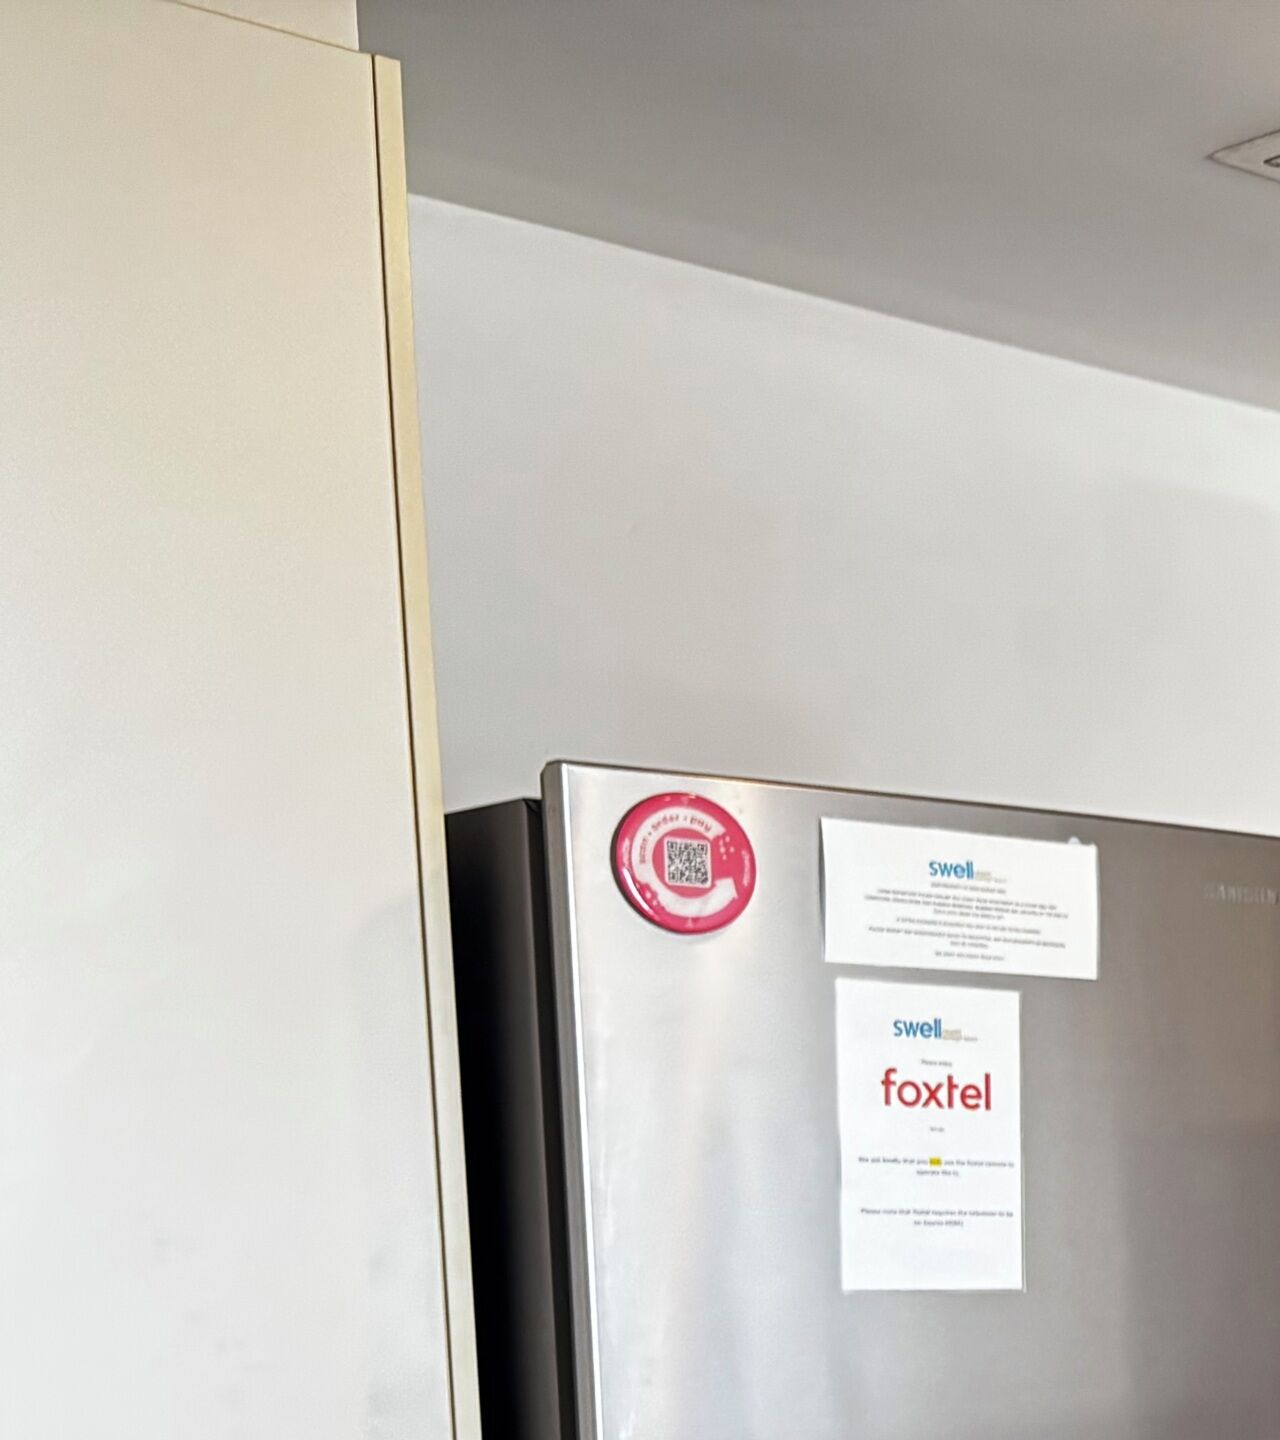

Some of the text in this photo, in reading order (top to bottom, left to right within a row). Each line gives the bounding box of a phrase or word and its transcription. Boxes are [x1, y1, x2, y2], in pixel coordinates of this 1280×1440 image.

[929, 860, 974, 879] swell
[893, 1017, 942, 1039] swell
[881, 1067, 991, 1112] foxtel
